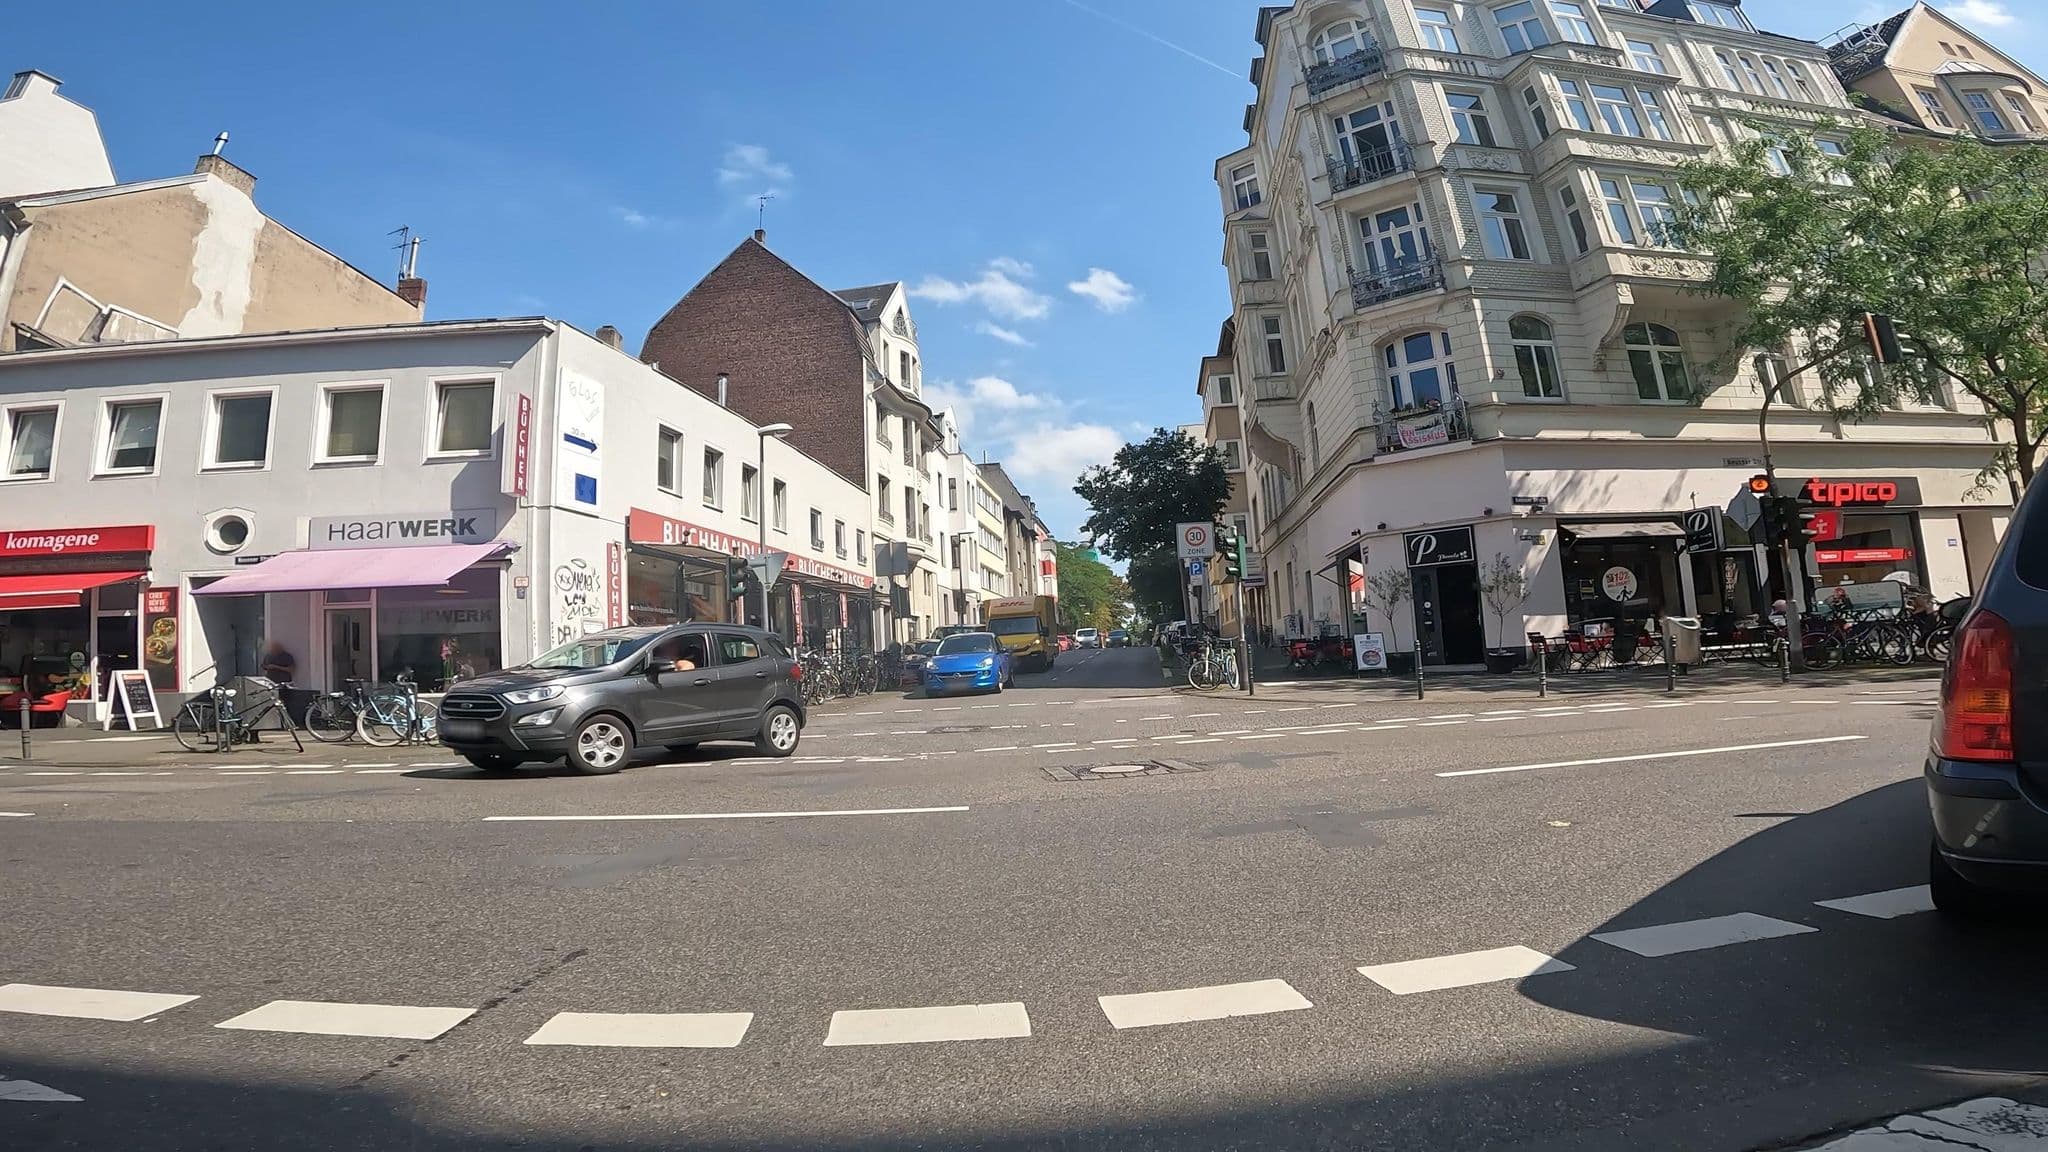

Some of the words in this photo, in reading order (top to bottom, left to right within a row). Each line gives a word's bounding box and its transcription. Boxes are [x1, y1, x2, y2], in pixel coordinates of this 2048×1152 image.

[1808, 477, 1897, 506] tipico
[328, 517, 477, 541] HaarWERK
[1189, 531, 1202, 542] 30
[6, 532, 100, 551] komagene
